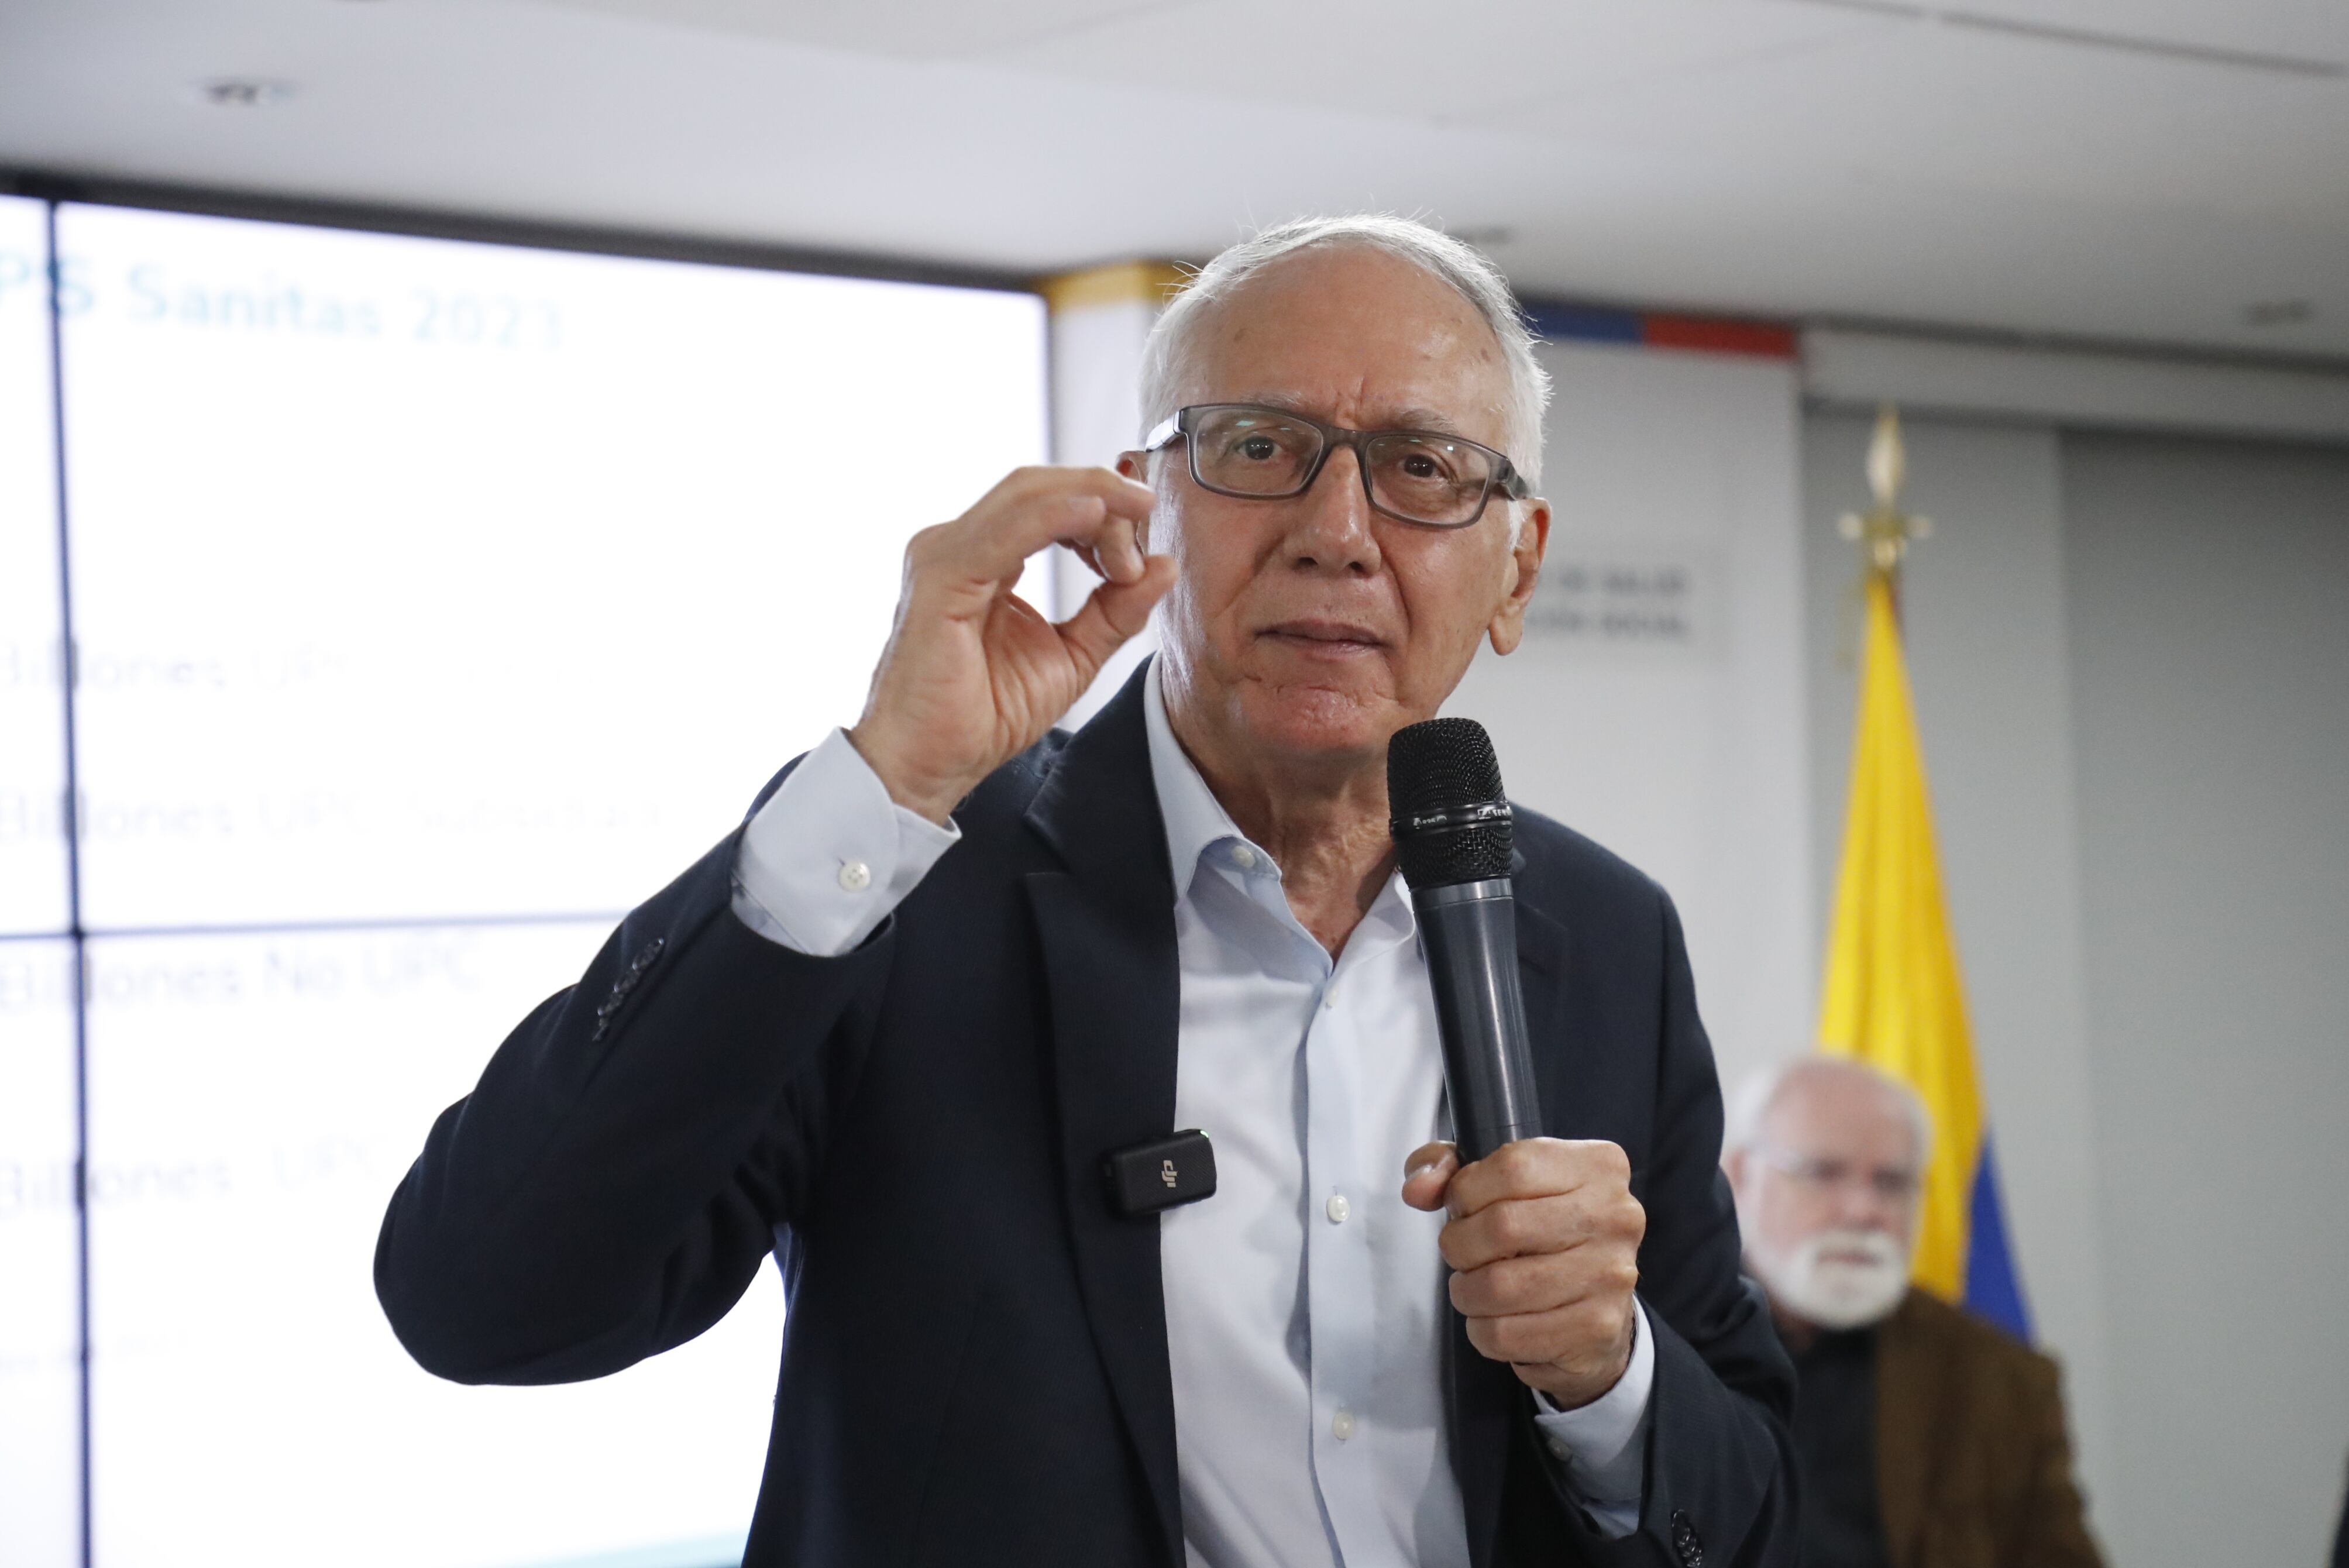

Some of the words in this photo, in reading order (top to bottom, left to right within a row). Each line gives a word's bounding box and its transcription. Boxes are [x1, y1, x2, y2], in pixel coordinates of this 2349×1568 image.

[124, 261, 383, 339] Sanitas
[262, 938, 348, 1000] No
[361, 930, 484, 996] UPC
